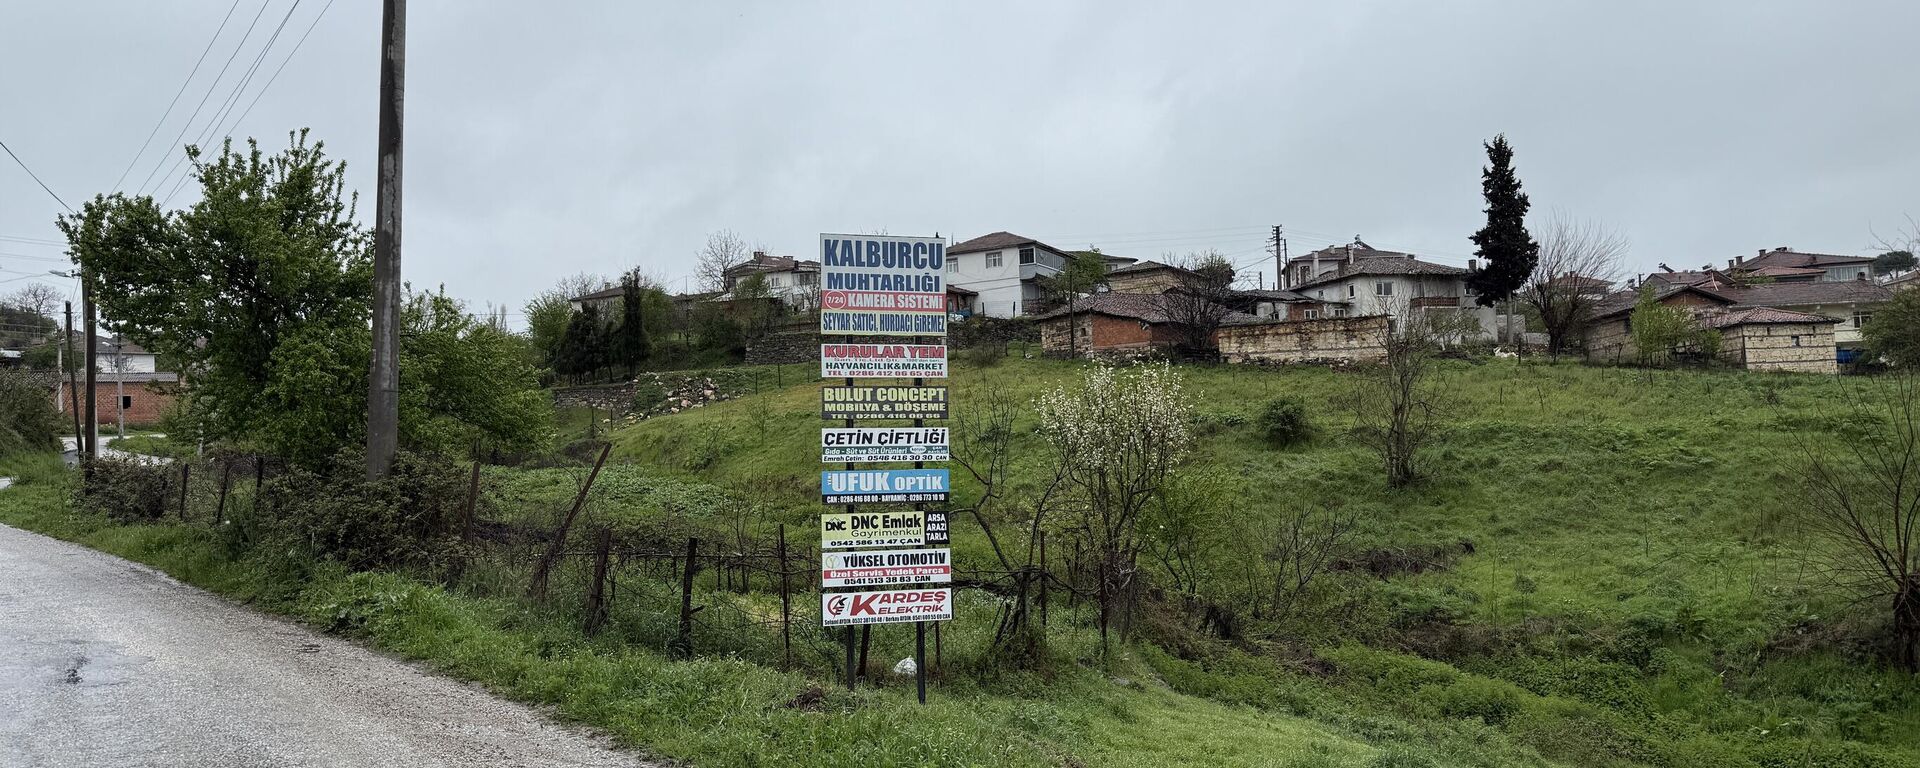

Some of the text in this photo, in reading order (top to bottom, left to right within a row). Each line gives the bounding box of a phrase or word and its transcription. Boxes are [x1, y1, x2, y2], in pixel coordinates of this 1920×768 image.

[824, 239, 943, 269] KALBURCU
[827, 272, 940, 292] MUHTARLIĞI
[827, 296, 843, 304] 7/24
[848, 293, 896, 307] KAMERA
[823, 312, 851, 331] SEYYAR
[880, 314, 912, 332] HURDACI
[824, 345, 945, 359] KURULAR YEM
[823, 387, 946, 402] BULUT CONCEPT
[882, 404, 892, 412] &
[894, 402, 946, 413] DÖŞEME
[824, 428, 946, 446] ÇETİN ÇİFTLİĞİ
[846, 447, 858, 455] Süt
[880, 446, 908, 454] Ürünleri
[831, 472, 891, 492] UFUK
[894, 473, 944, 491] OPTİK
[851, 514, 922, 530] DNC Emlak
[927, 513, 946, 522] ARSA
[825, 521, 847, 531] DNC
[851, 528, 922, 538] Gayrimenkul
[926, 532, 948, 541] TARLA
[843, 551, 946, 568] YÜKSEL OTOMOTİV
[830, 570, 850, 578] Özel
[852, 569, 884, 577] Servis
[885, 568, 915, 576] Yedek
[850, 591, 947, 616] KARDEŞ
[878, 604, 944, 615] ELEKTRİK
